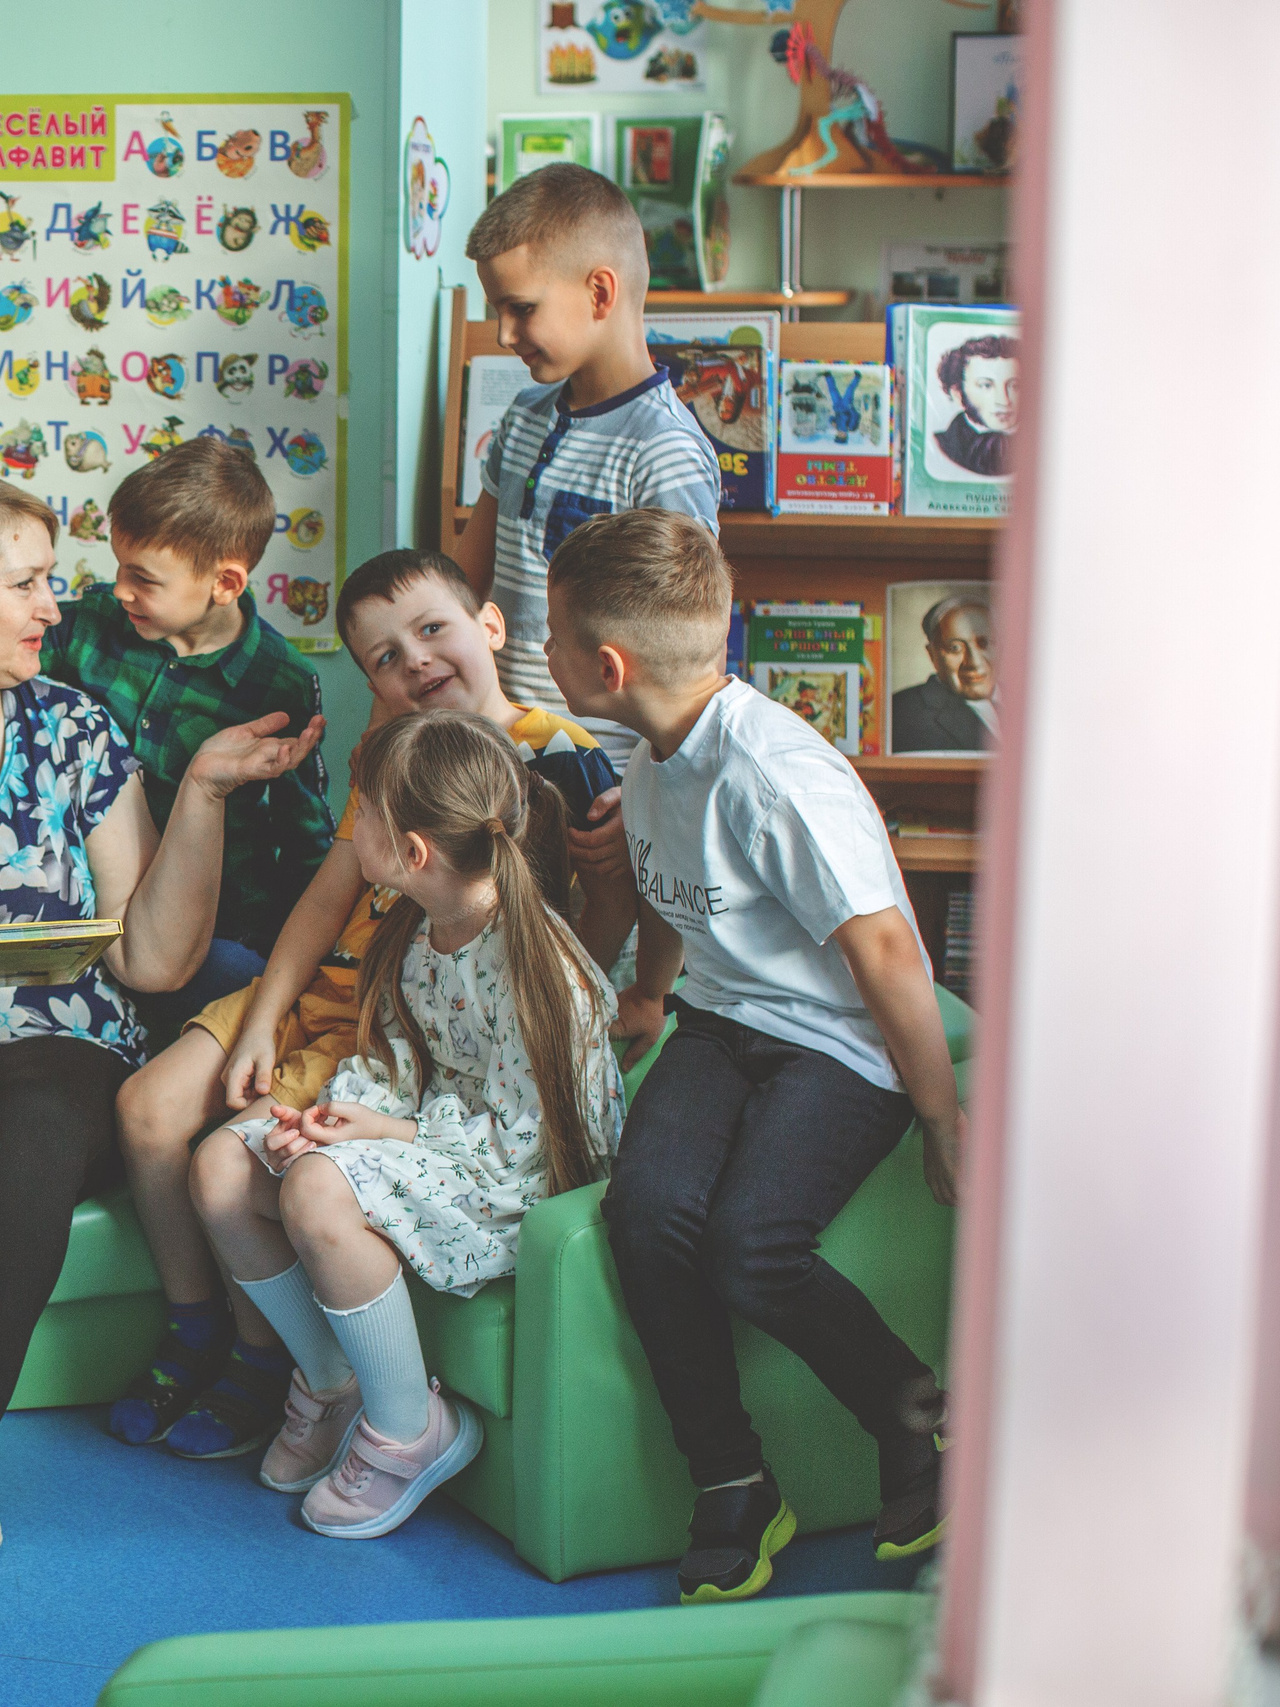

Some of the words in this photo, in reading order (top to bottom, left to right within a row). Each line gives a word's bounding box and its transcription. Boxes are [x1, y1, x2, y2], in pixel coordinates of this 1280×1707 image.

[122, 131, 150, 161] А
[196, 130, 218, 161] Б
[269, 131, 291, 161] В
[46, 203, 75, 241] Д
[122, 204, 140, 234] Е
[196, 195, 214, 235] Ё
[269, 203, 306, 235] Ж
[46, 277, 70, 308] И
[121, 268, 147, 309] Й
[195, 279, 217, 310] К
[268, 280, 295, 311] Л
[46, 350, 69, 381] Н
[121, 351, 149, 382] О
[196, 352, 220, 383] П
[268, 354, 290, 385] Р
[46, 421, 69, 451] Т
[122, 423, 146, 455] У
[266, 426, 289, 459] Х
[267, 573, 289, 604] Я
[638, 866, 729, 916] BALANCE
